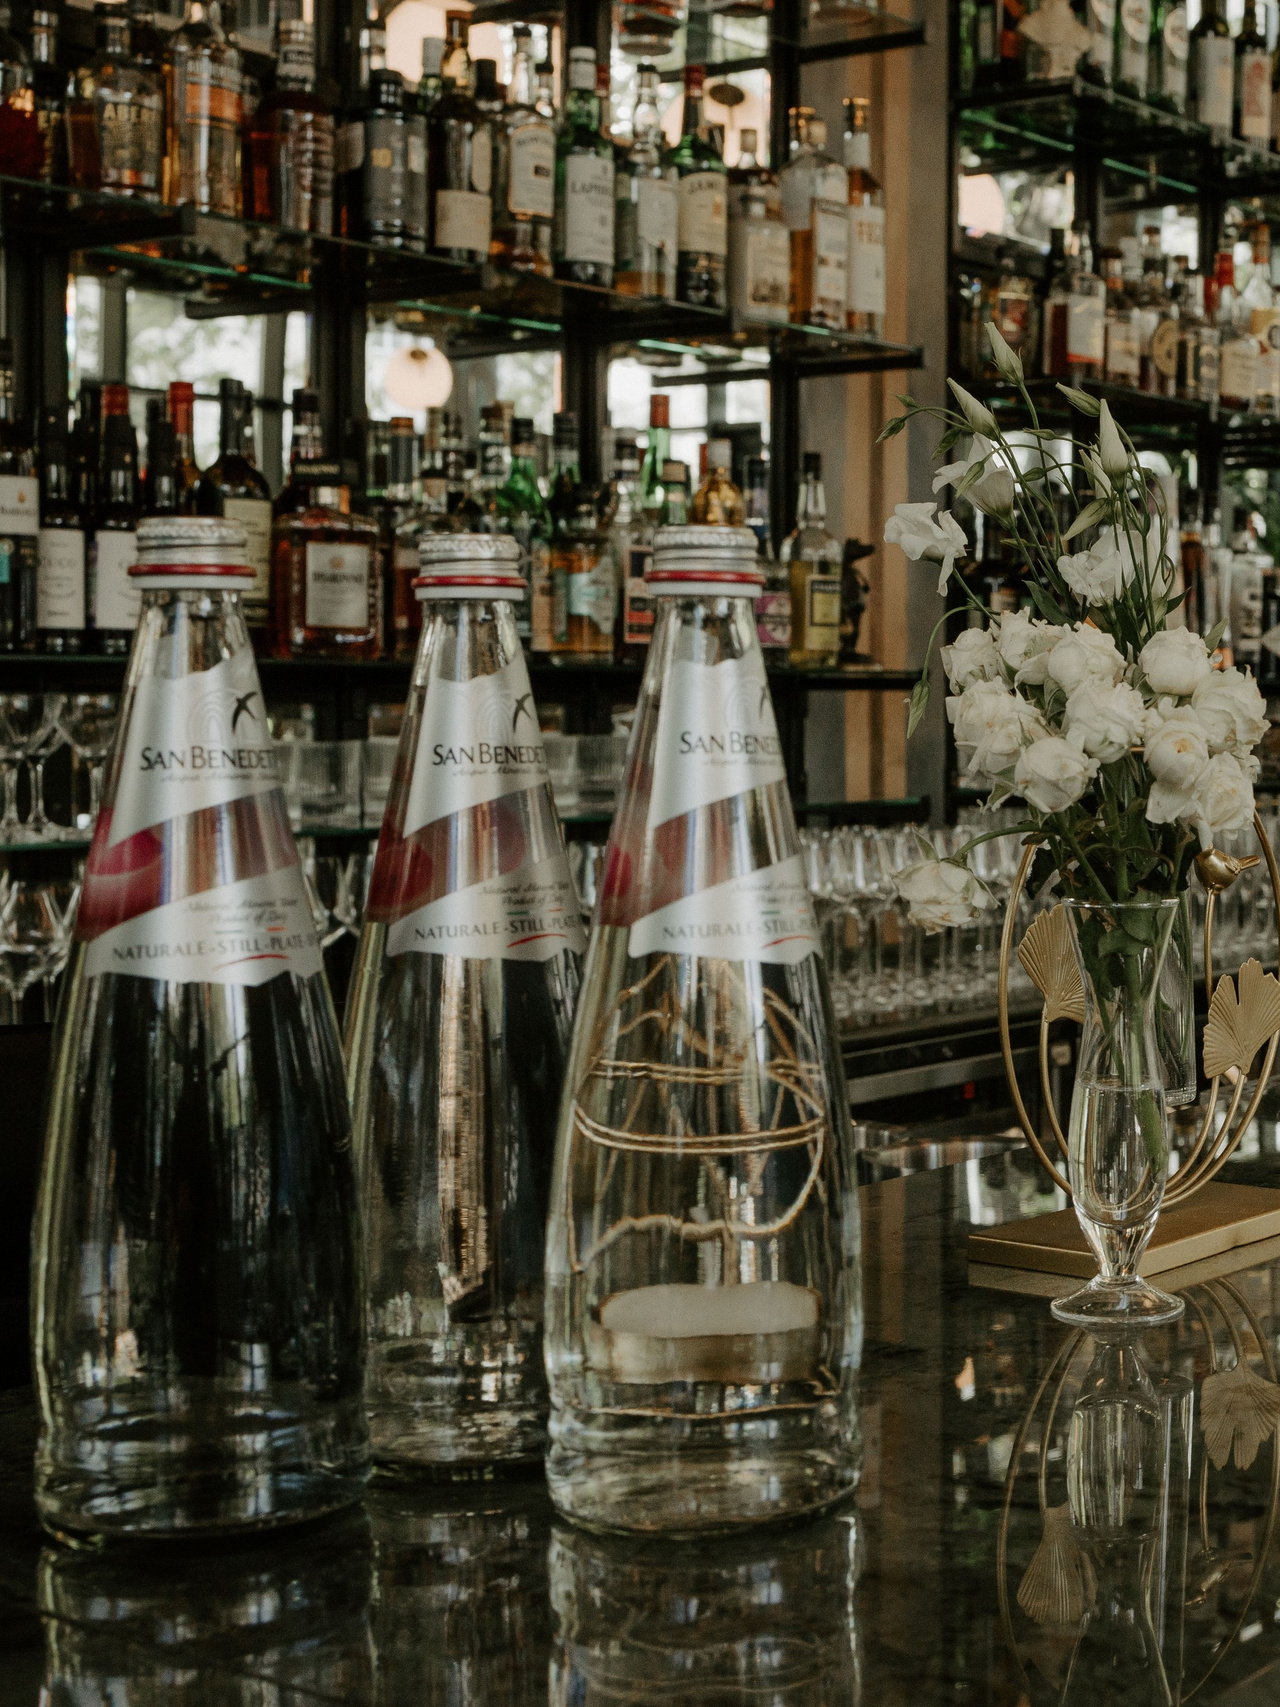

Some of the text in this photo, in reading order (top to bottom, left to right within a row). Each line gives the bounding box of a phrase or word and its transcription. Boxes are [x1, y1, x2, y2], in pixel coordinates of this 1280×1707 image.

[680, 731, 724, 754] SAN
[140, 746, 185, 770] SAN
[432, 744, 475, 766] SAN
[414, 922, 500, 940] NATURALE
[113, 941, 205, 960] NATURALE
